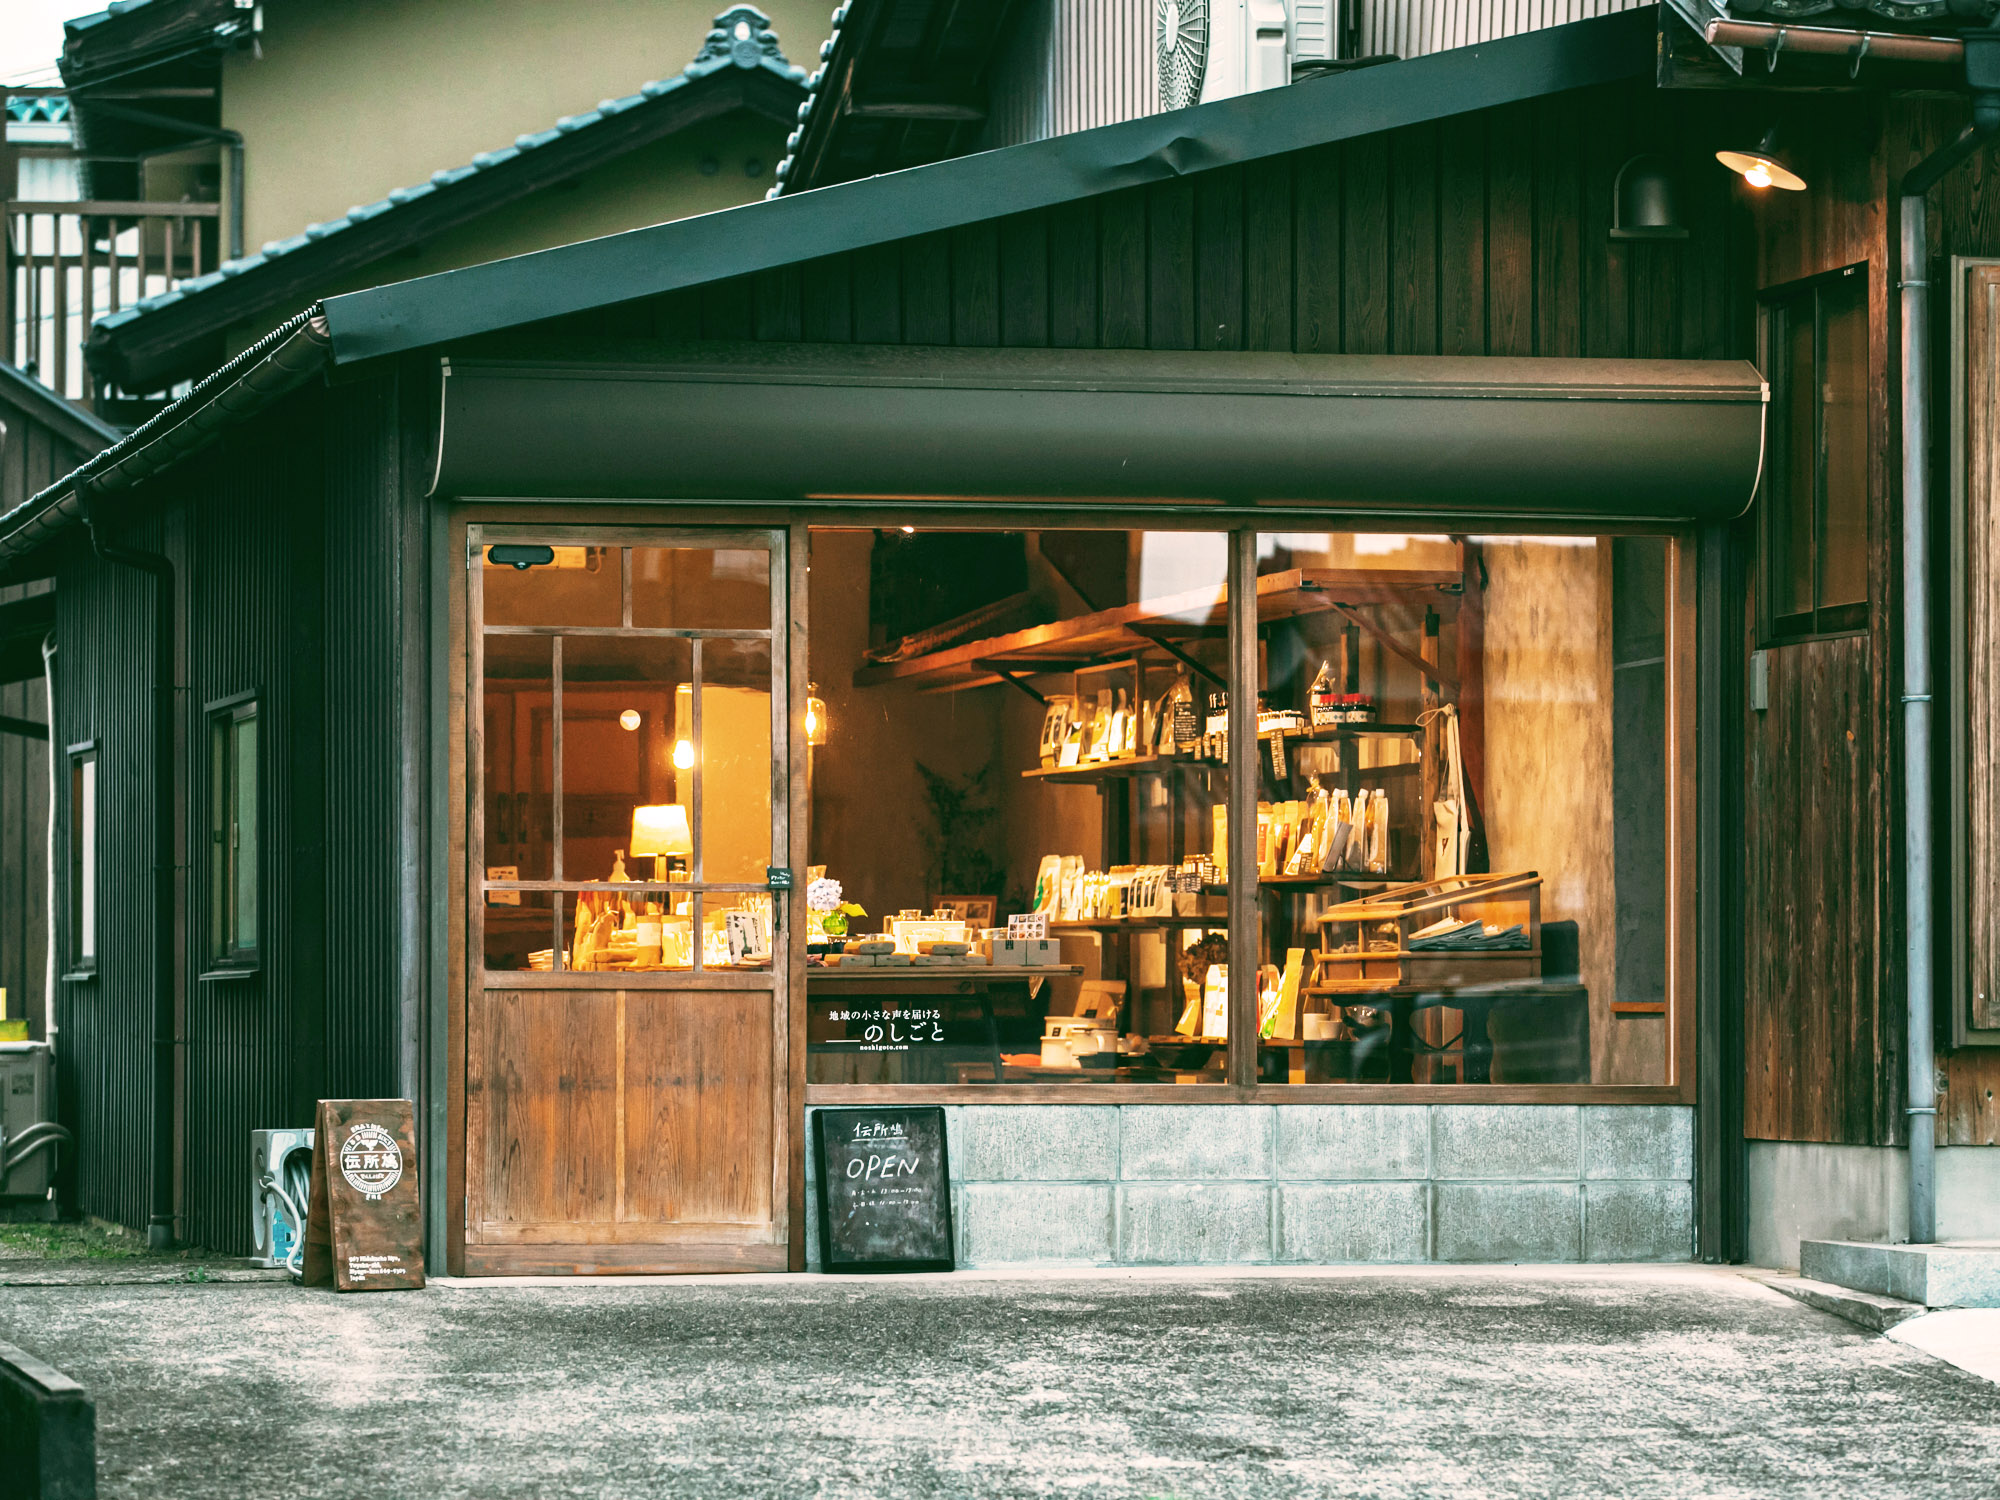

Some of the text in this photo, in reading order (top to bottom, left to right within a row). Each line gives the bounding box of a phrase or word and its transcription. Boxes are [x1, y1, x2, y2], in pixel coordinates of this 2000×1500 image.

[829, 1009, 941, 1021] 地域の小さな声を届ける
[344, 1153, 398, 1169] 伝所鳩
[846, 1154, 920, 1181] OPEN
